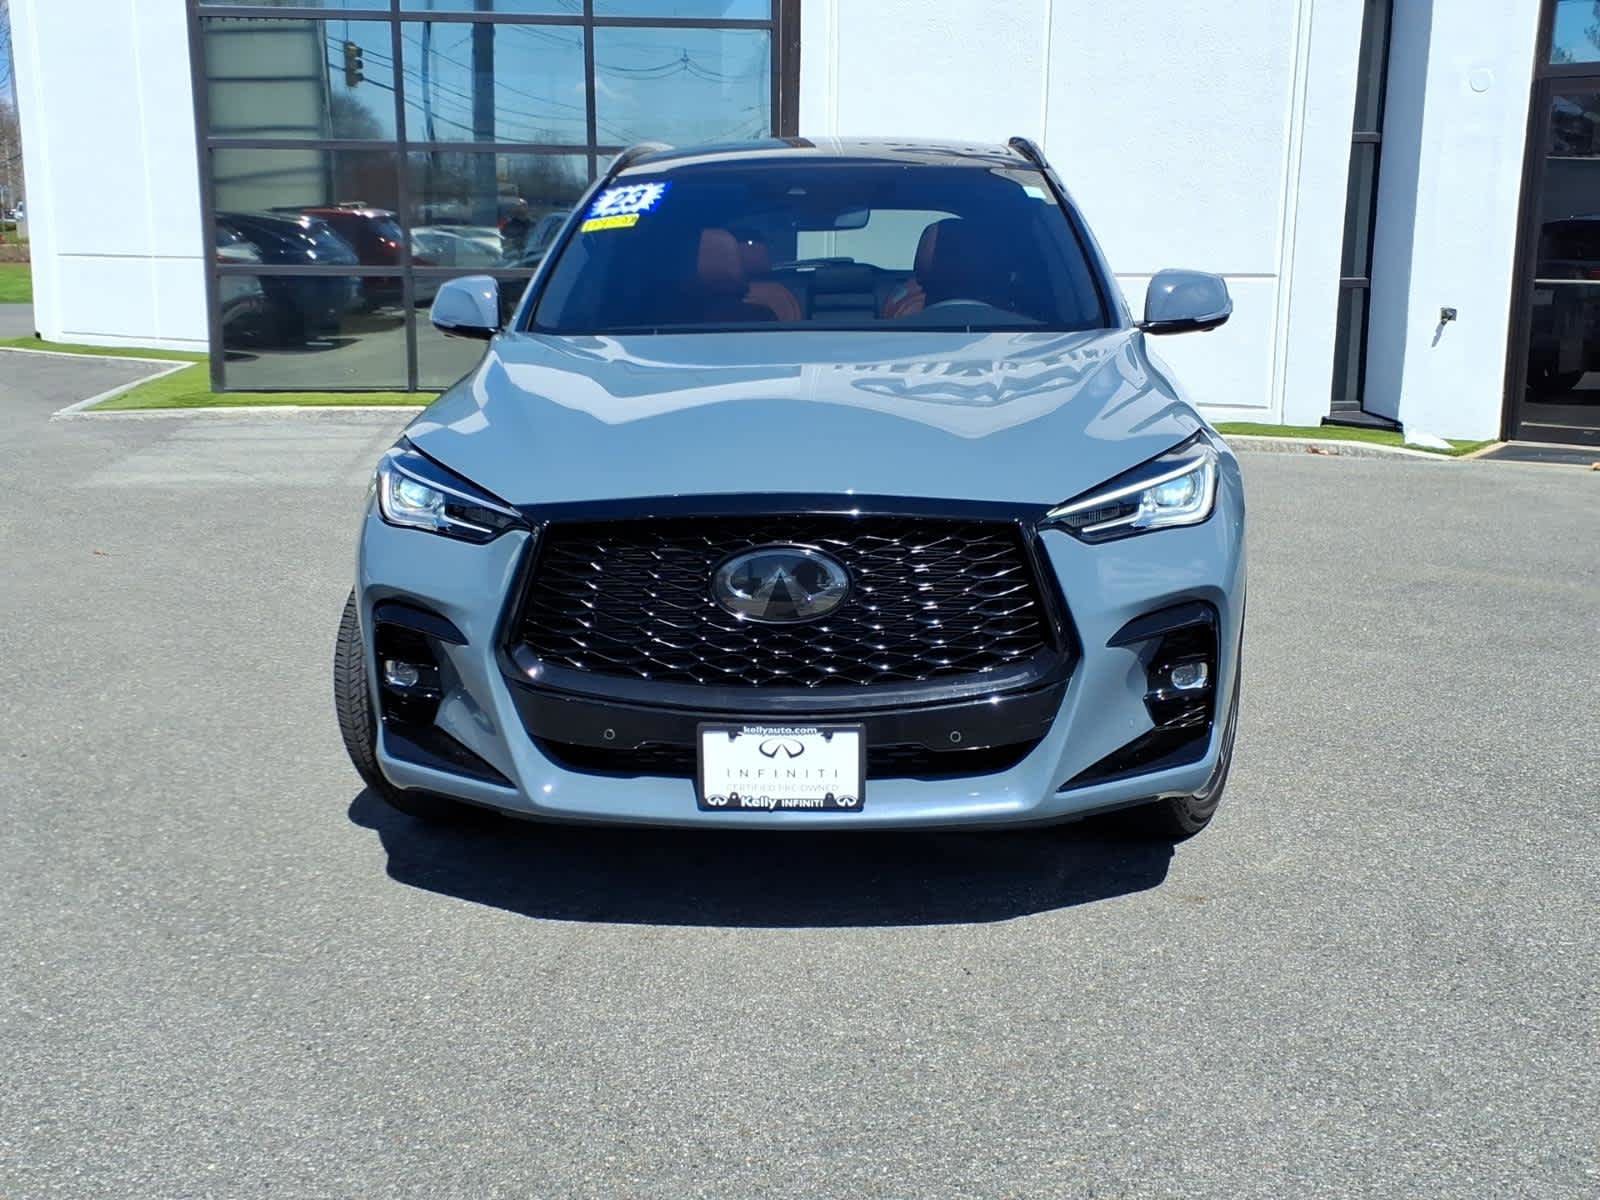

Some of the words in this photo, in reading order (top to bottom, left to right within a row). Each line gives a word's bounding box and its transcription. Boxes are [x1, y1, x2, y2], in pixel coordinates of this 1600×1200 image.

[743, 726, 817, 735] kellyauto.com
[727, 769, 838, 777] INFINITI
[741, 796, 777, 810] Kelly
[781, 800, 824, 808] INFINITI
